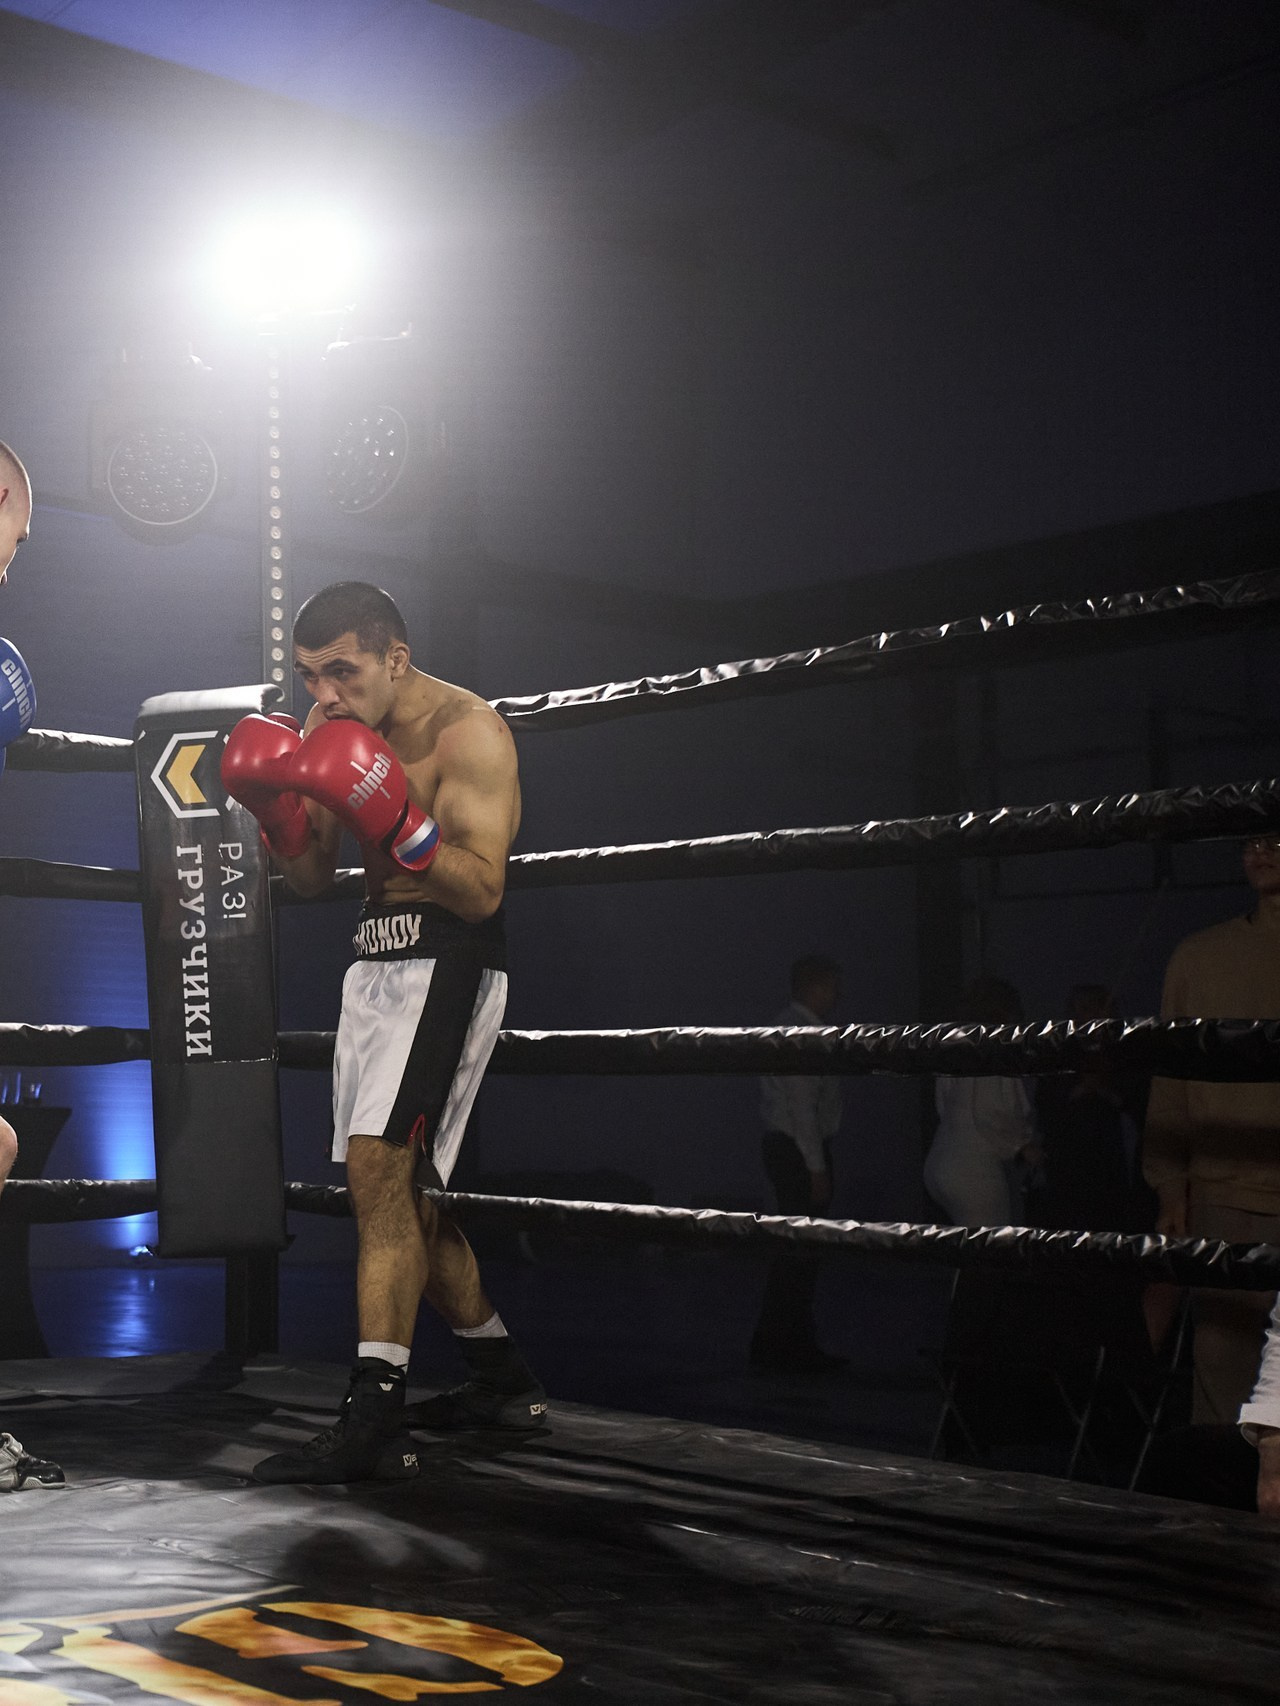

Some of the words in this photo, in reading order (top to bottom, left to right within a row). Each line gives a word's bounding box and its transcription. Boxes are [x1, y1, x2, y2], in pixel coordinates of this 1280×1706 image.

[0, 658, 33, 729] clinch
[347, 751, 392, 811] clinch
[176, 844, 213, 1058] ГРУЗЧИКИ
